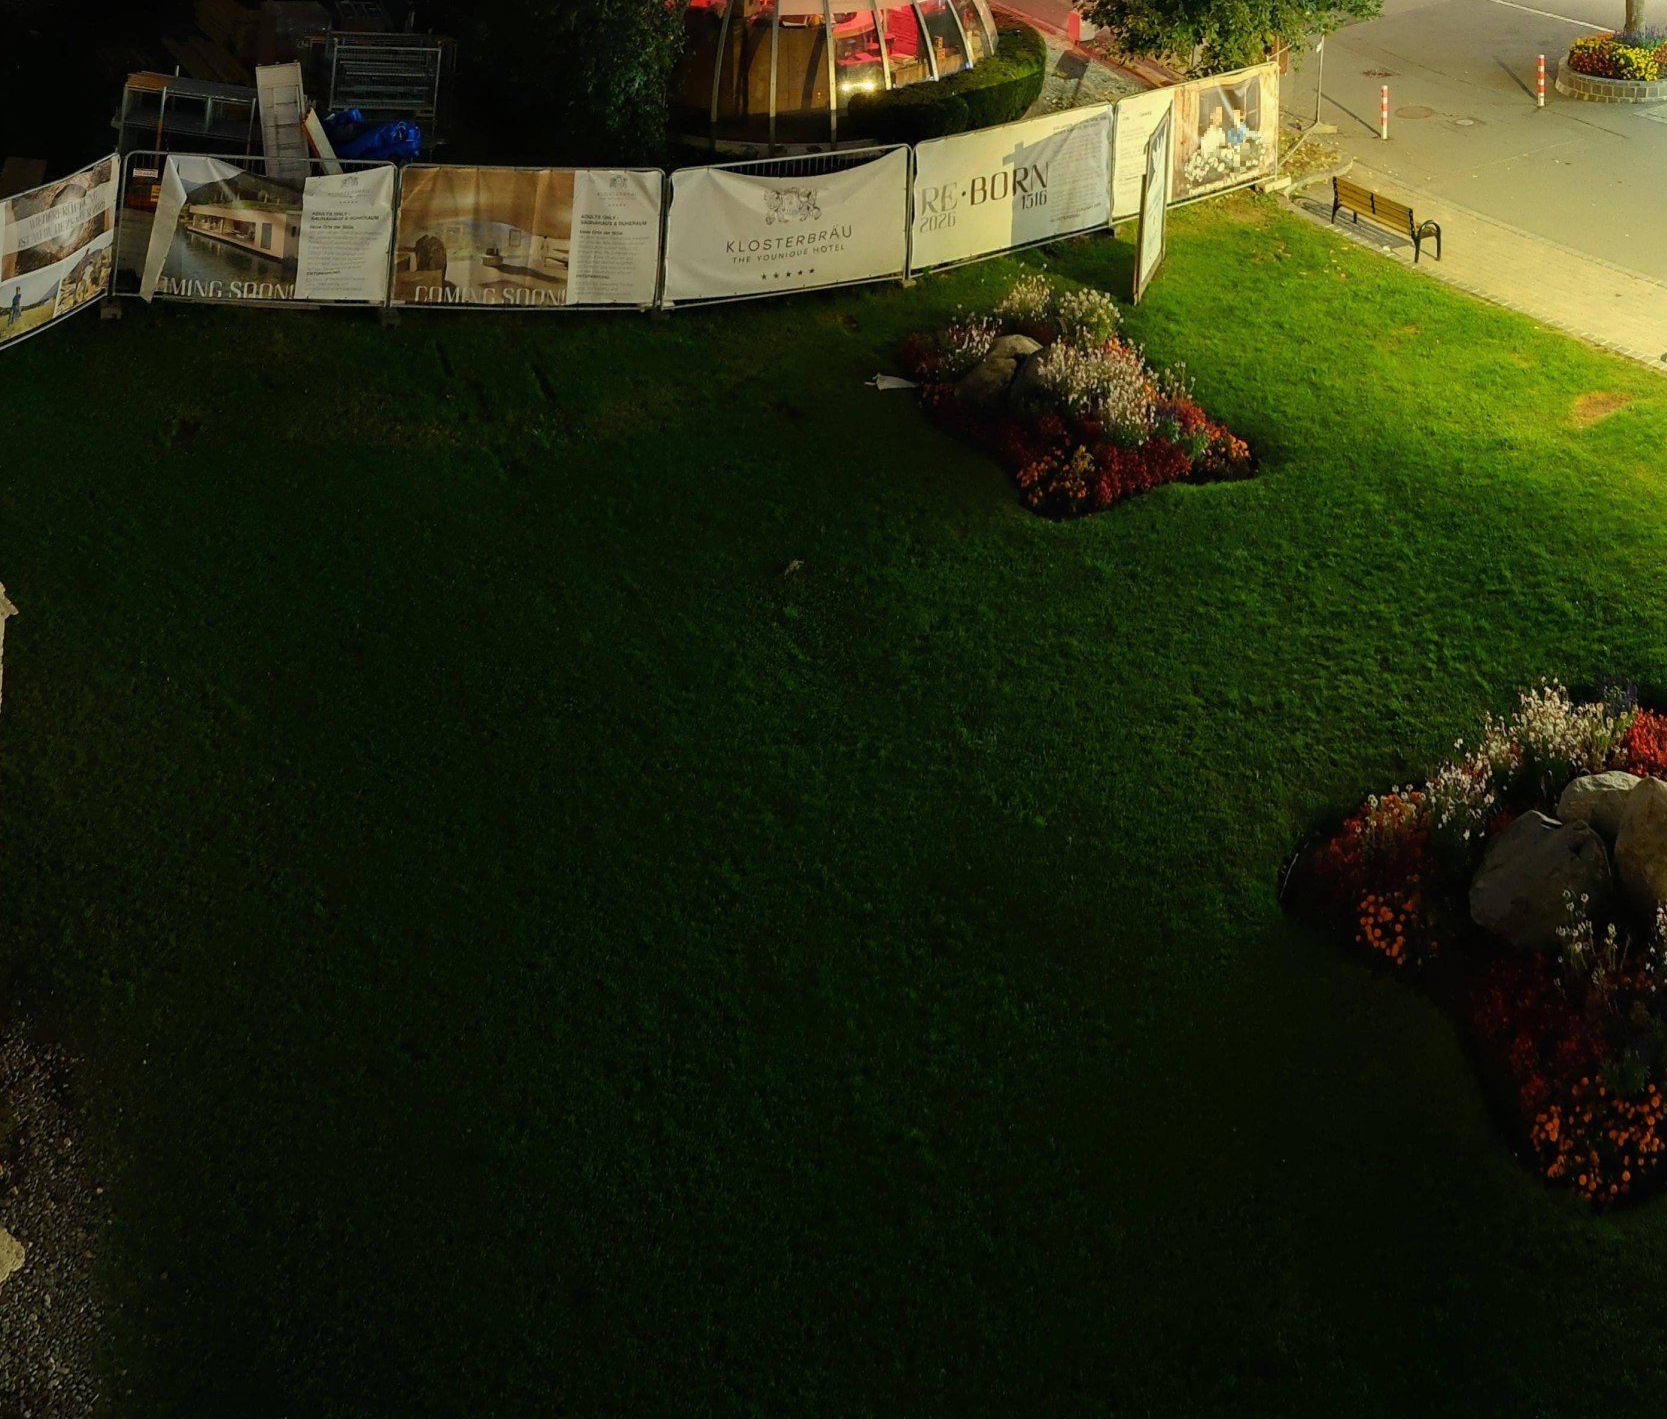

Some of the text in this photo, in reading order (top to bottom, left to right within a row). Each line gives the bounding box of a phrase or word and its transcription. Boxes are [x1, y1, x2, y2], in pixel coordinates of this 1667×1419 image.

[1021, 189, 1048, 211] 1516
[919, 211, 957, 233] 2026
[726, 224, 853, 254] KLOSTERBRÄU
[732, 243, 845, 264] THE YOUNIQUE HOTEL
[415, 284, 495, 305] COMING
